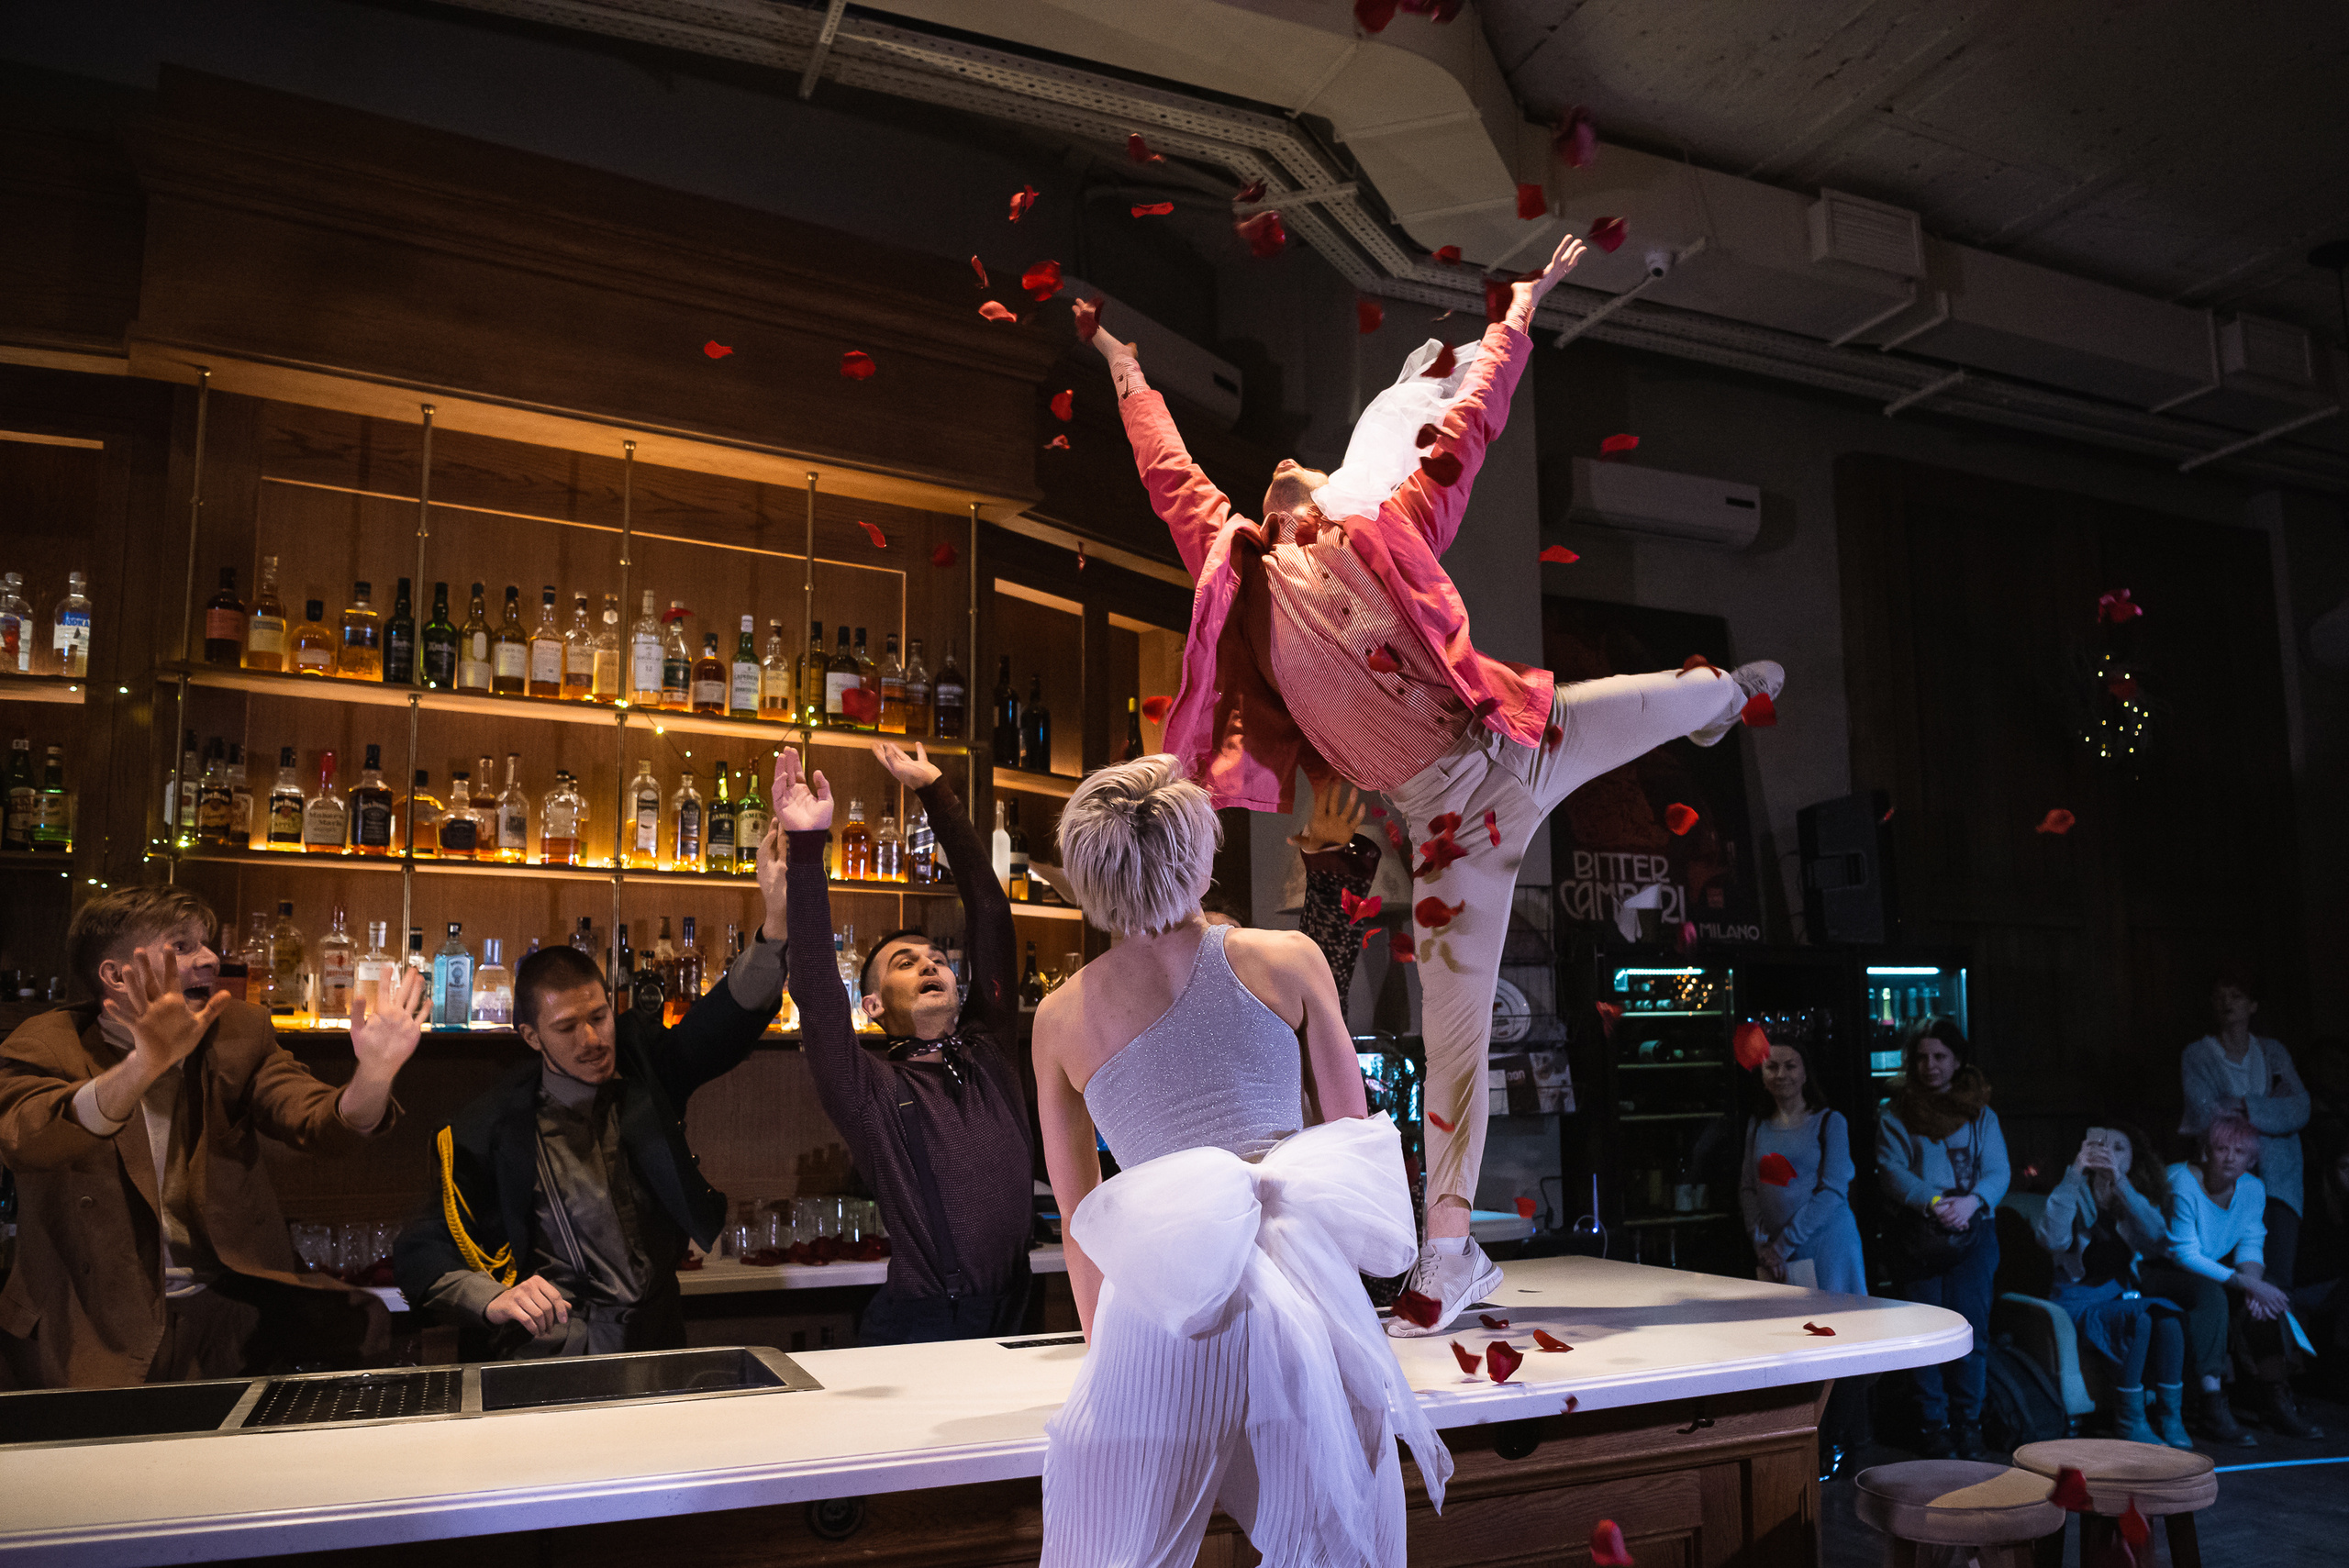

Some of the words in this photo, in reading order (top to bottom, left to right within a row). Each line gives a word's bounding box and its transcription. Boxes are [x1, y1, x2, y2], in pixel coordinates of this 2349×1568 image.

[1573, 851, 1670, 883] BITTER
[1560, 879, 1687, 924] CAMPRI
[1699, 923, 1761, 941] MILANO
